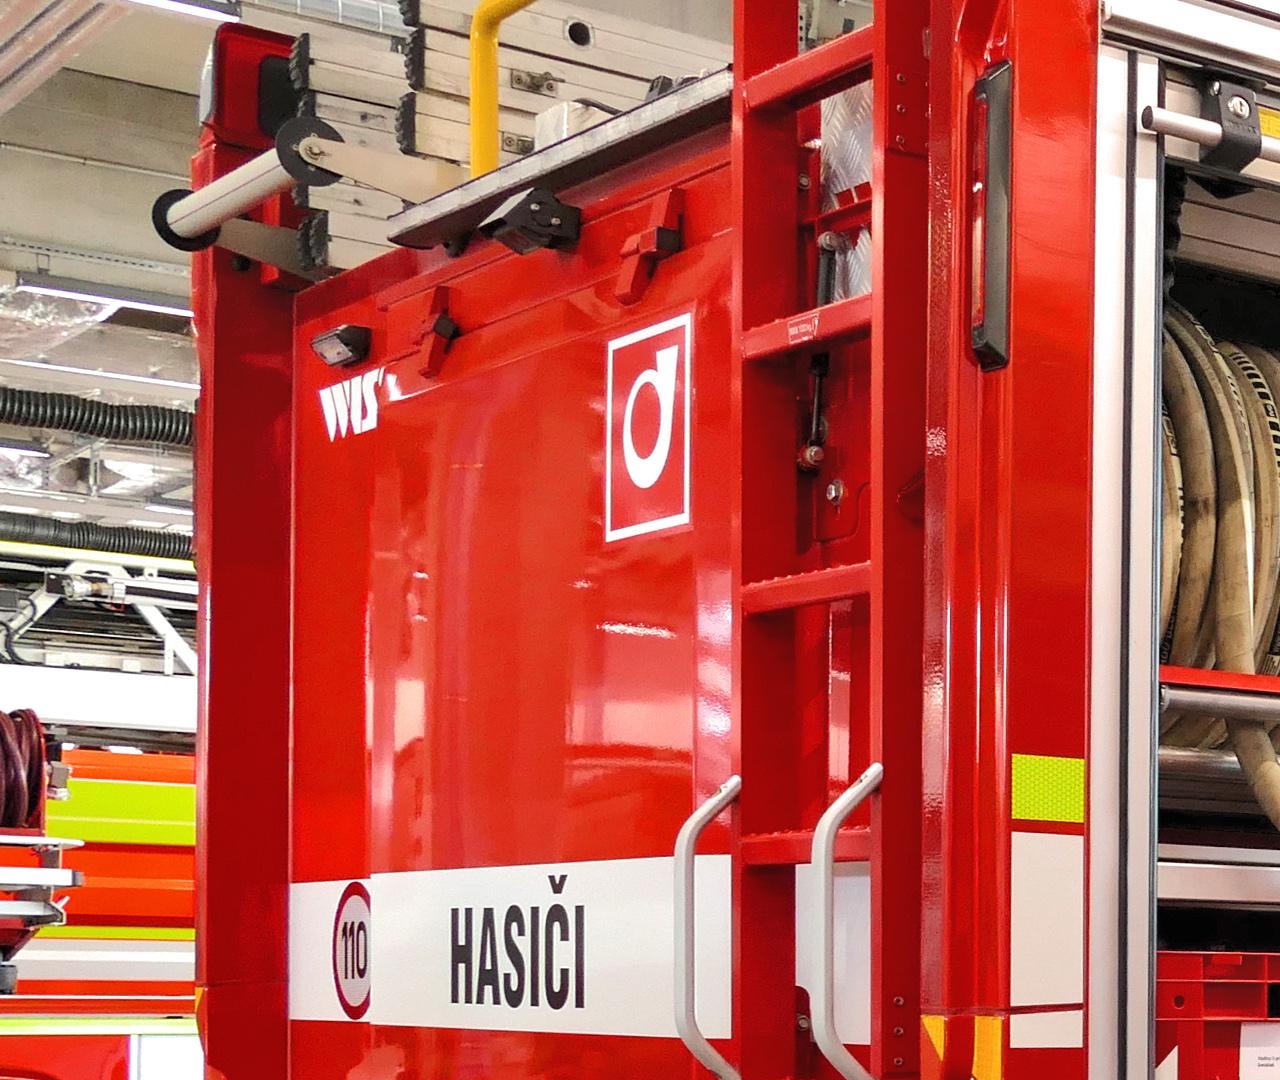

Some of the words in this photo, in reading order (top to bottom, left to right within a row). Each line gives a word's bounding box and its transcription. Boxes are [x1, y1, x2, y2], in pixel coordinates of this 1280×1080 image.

[319, 366, 388, 442] WIS
[341, 921, 368, 980] 110
[450, 874, 586, 1010] HASIČI
